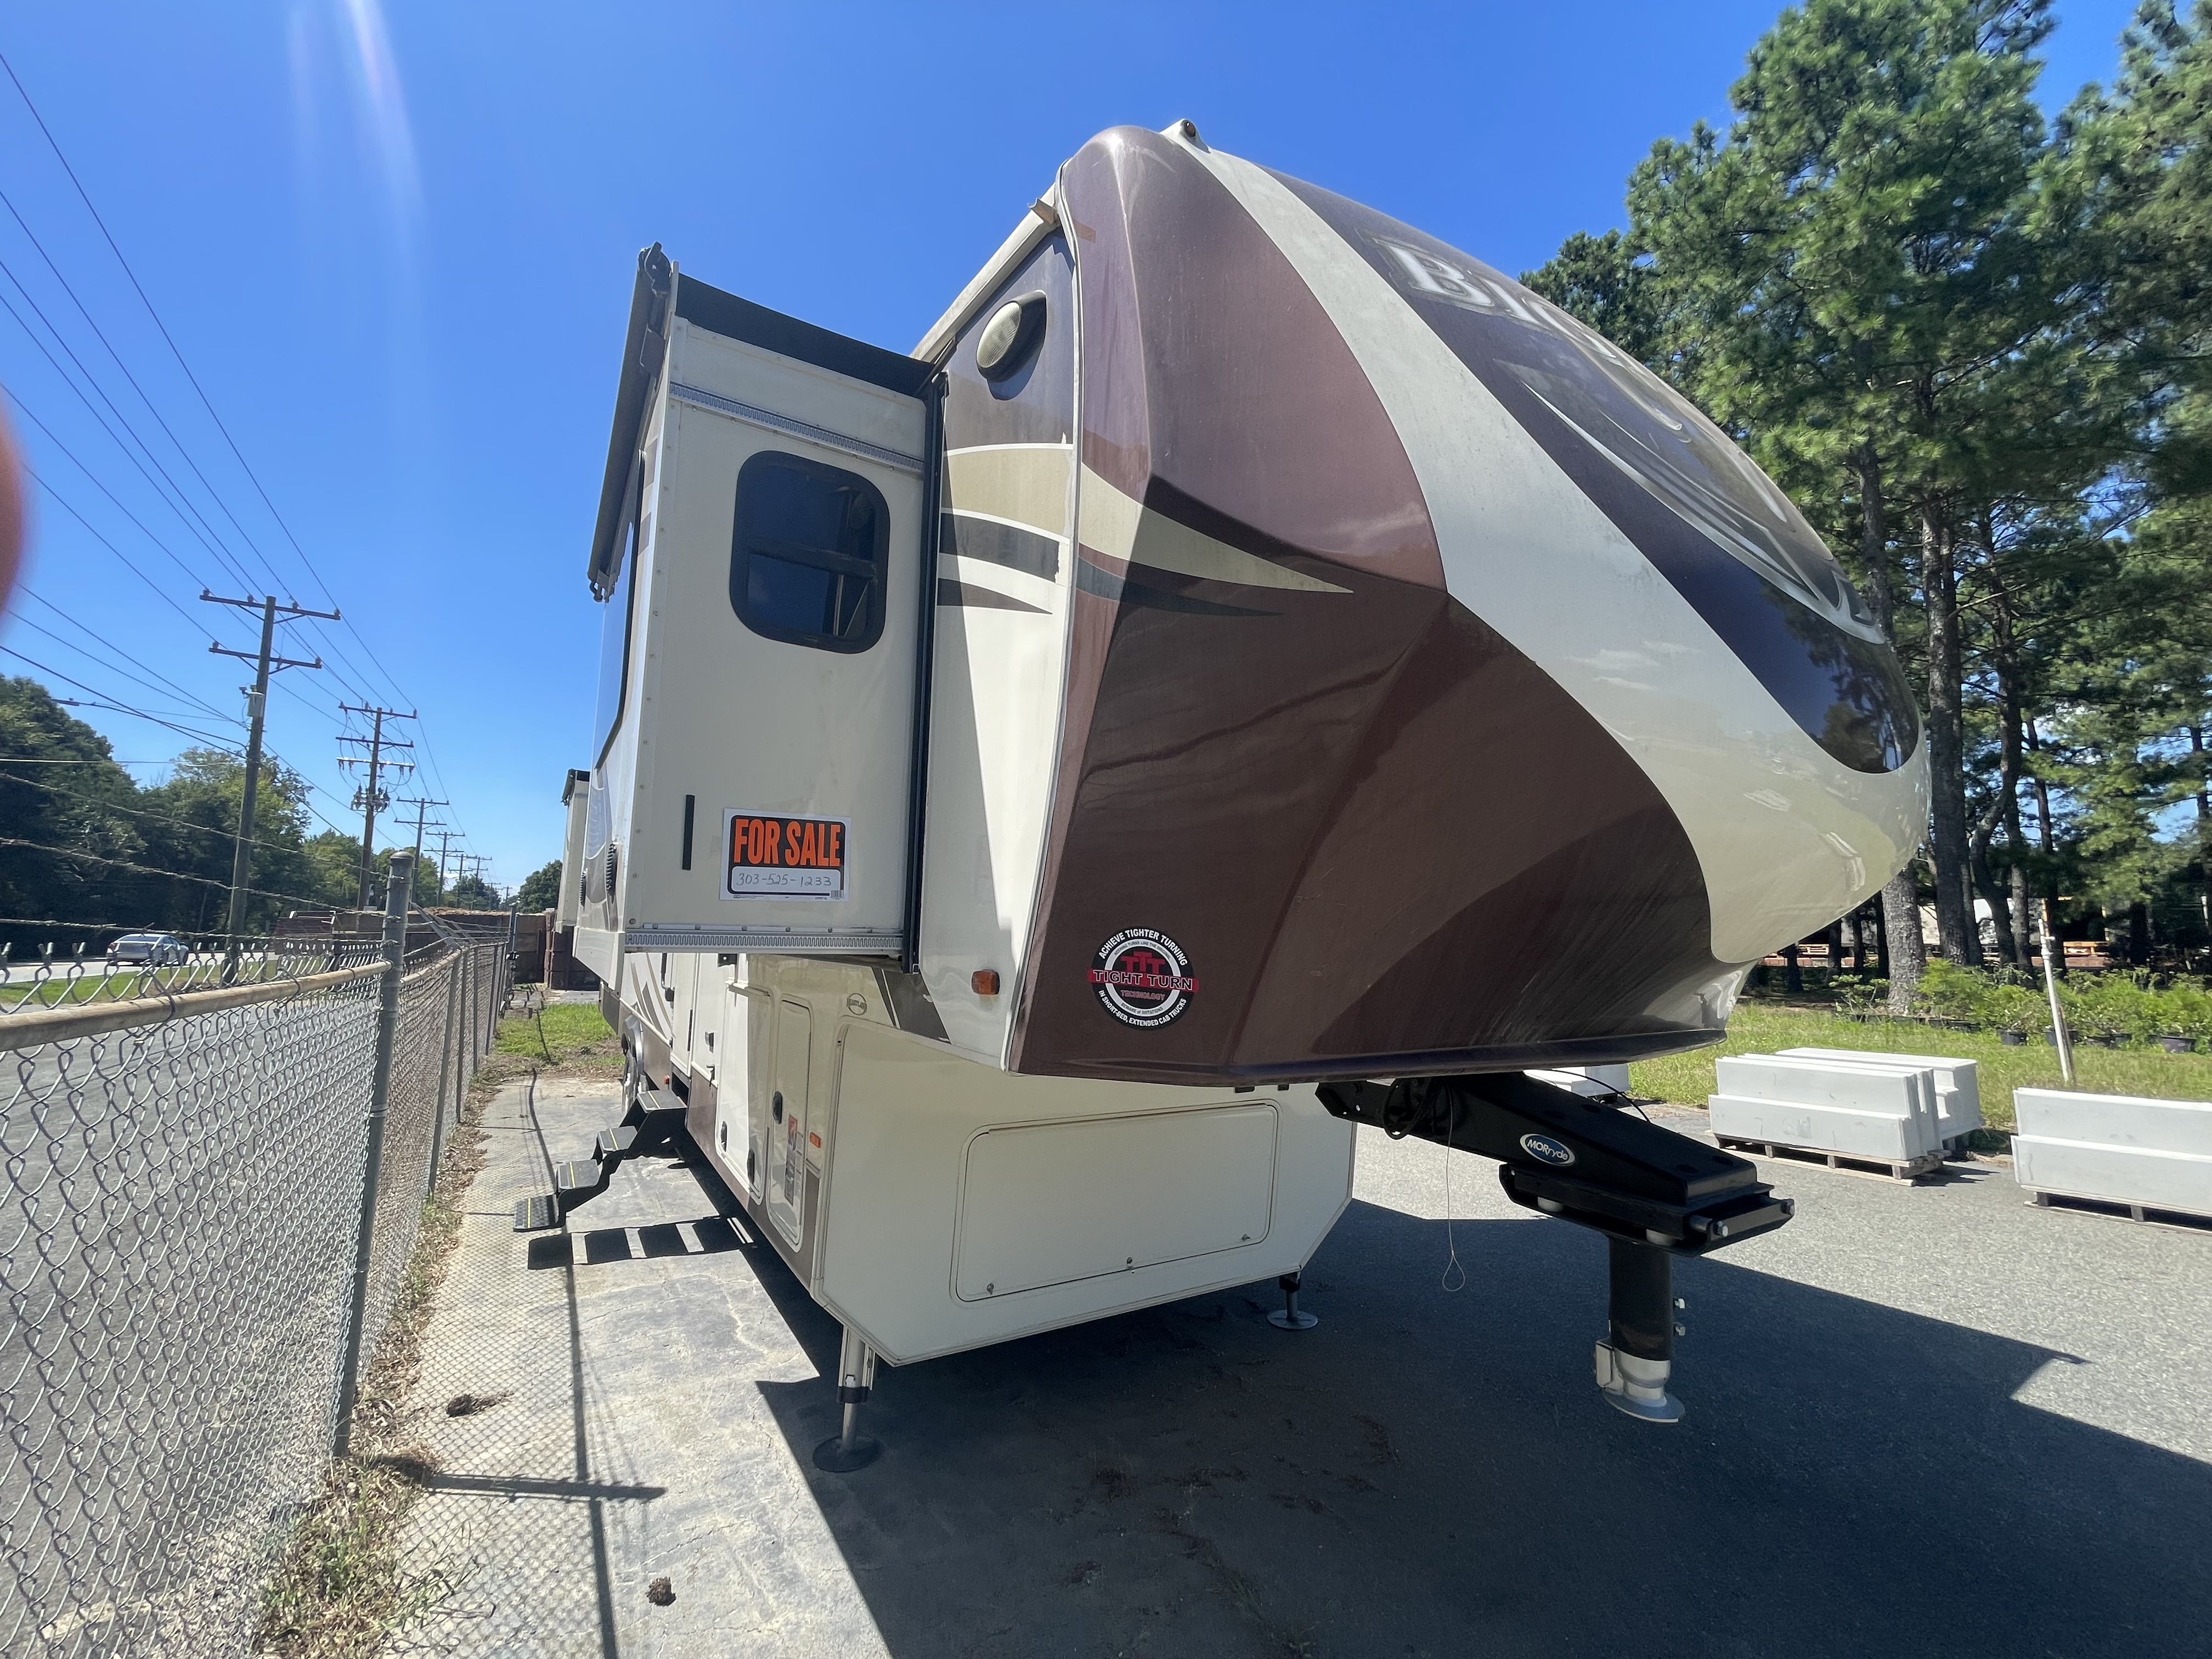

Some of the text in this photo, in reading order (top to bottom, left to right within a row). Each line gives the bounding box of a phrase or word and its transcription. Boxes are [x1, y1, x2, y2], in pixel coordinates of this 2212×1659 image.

[733, 819, 840, 867] FOR SALE
[736, 872, 832, 887] 303-525-1233
[1099, 929, 1187, 966] ACHIEVE TIGHTER TURNING
[1093, 970, 1193, 991] TIGHT TURN
[1120, 990, 1165, 1001] TECHNOLOGY
[1102, 996, 1128, 1023] SHORT-BED,
[1128, 1017, 1159, 1026] EXTENDED
[1159, 1014, 1171, 1024] CAB
[1168, 998, 1187, 1018] TRUCKS
[1121, 1002, 1136, 1013] BEWARE
[1527, 1139, 1568, 1160] MORryde
